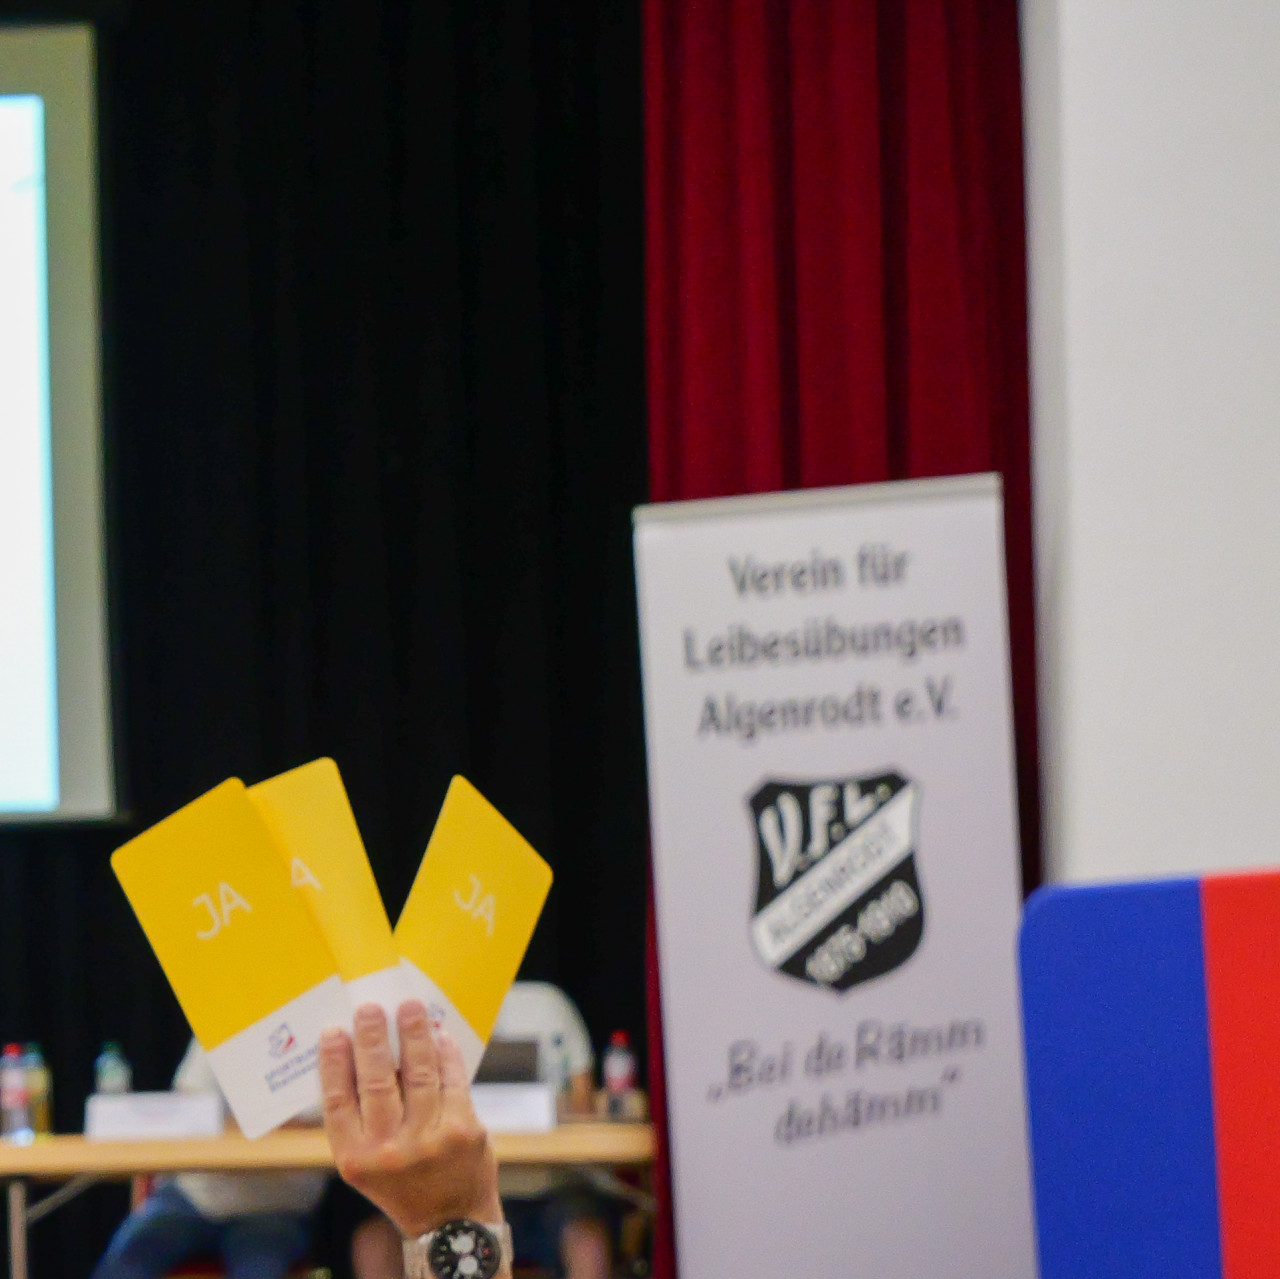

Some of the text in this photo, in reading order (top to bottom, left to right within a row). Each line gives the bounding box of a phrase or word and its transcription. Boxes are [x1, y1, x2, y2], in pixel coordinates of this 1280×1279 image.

[727, 543, 907, 597] Verein für
[683, 615, 966, 673] Leibesübungen
[699, 672, 958, 746] Algenrodt e.V.
[289, 857, 323, 891] A
[192, 881, 252, 941] JA
[452, 874, 496, 936] JA
